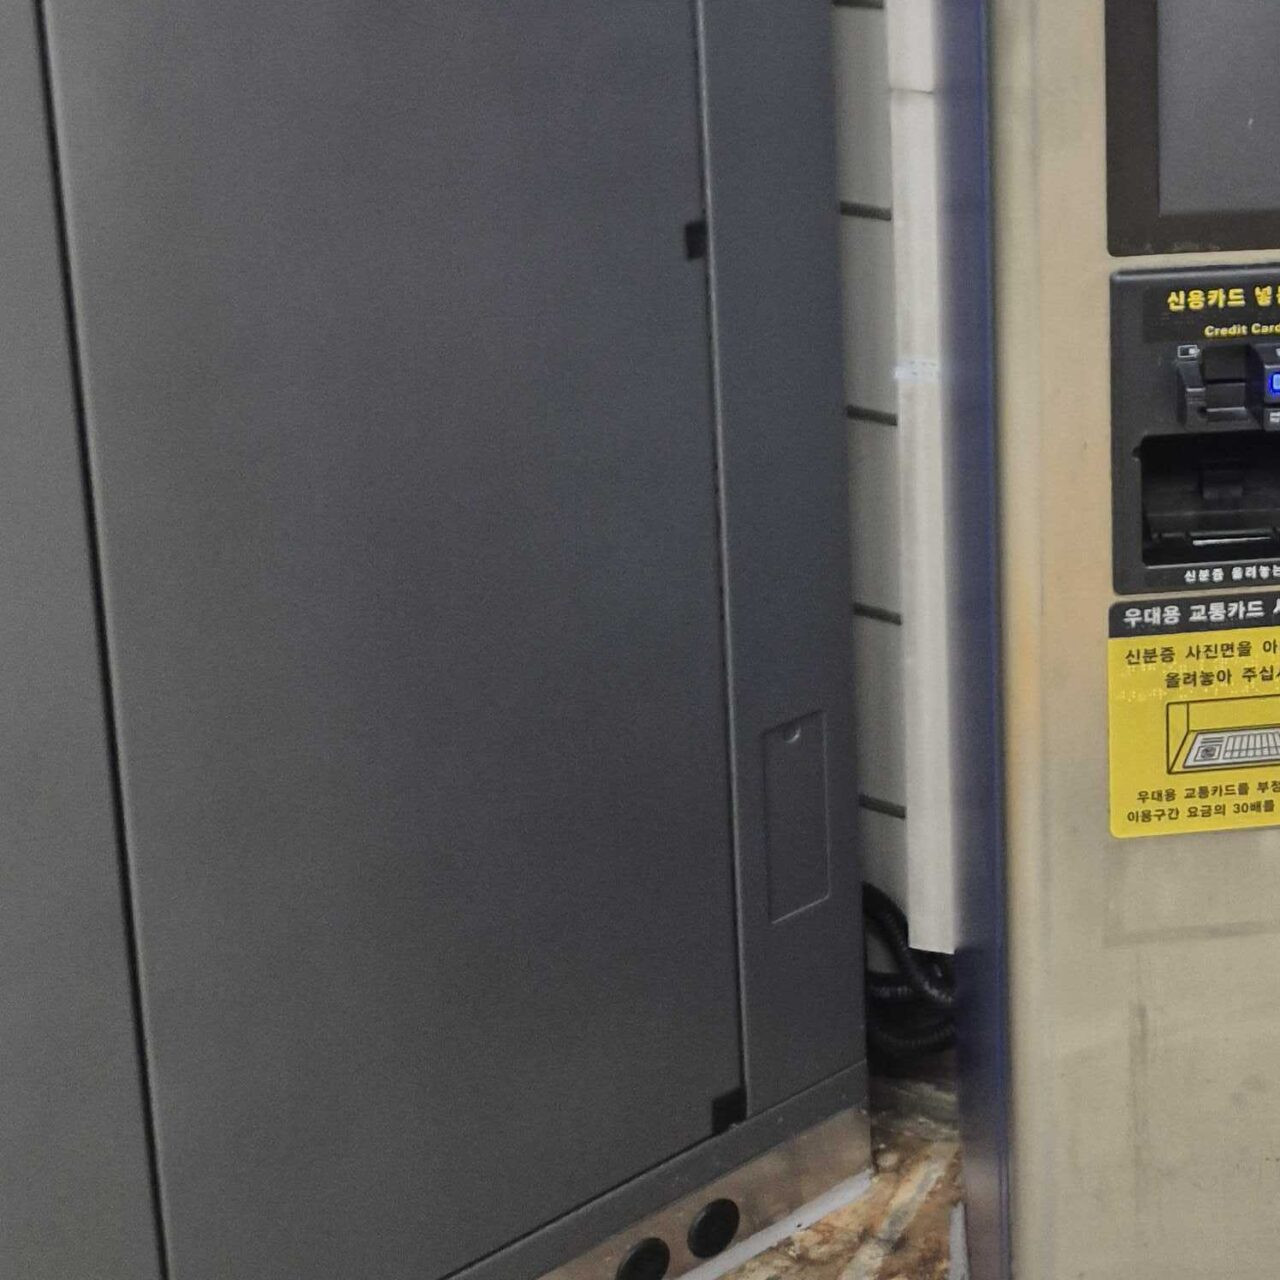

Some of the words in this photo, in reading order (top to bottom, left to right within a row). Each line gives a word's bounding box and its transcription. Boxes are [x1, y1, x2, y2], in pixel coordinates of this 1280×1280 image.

[1167, 288, 1245, 312] 신용카드
[1205, 324, 1248, 338] Credit
[1123, 606, 1181, 628] 우대용
[1189, 599, 1264, 623] 교통카드
[1125, 647, 1176, 665] 신분증
[1185, 641, 1251, 661] 사진면을
[1165, 669, 1232, 689] 올려놓아
[1137, 788, 1176, 804] 우대용
[1184, 781, 1249, 800] 교통카드를
[1127, 807, 1179, 823] 이용구간
[1187, 804, 1226, 818] 요금의
